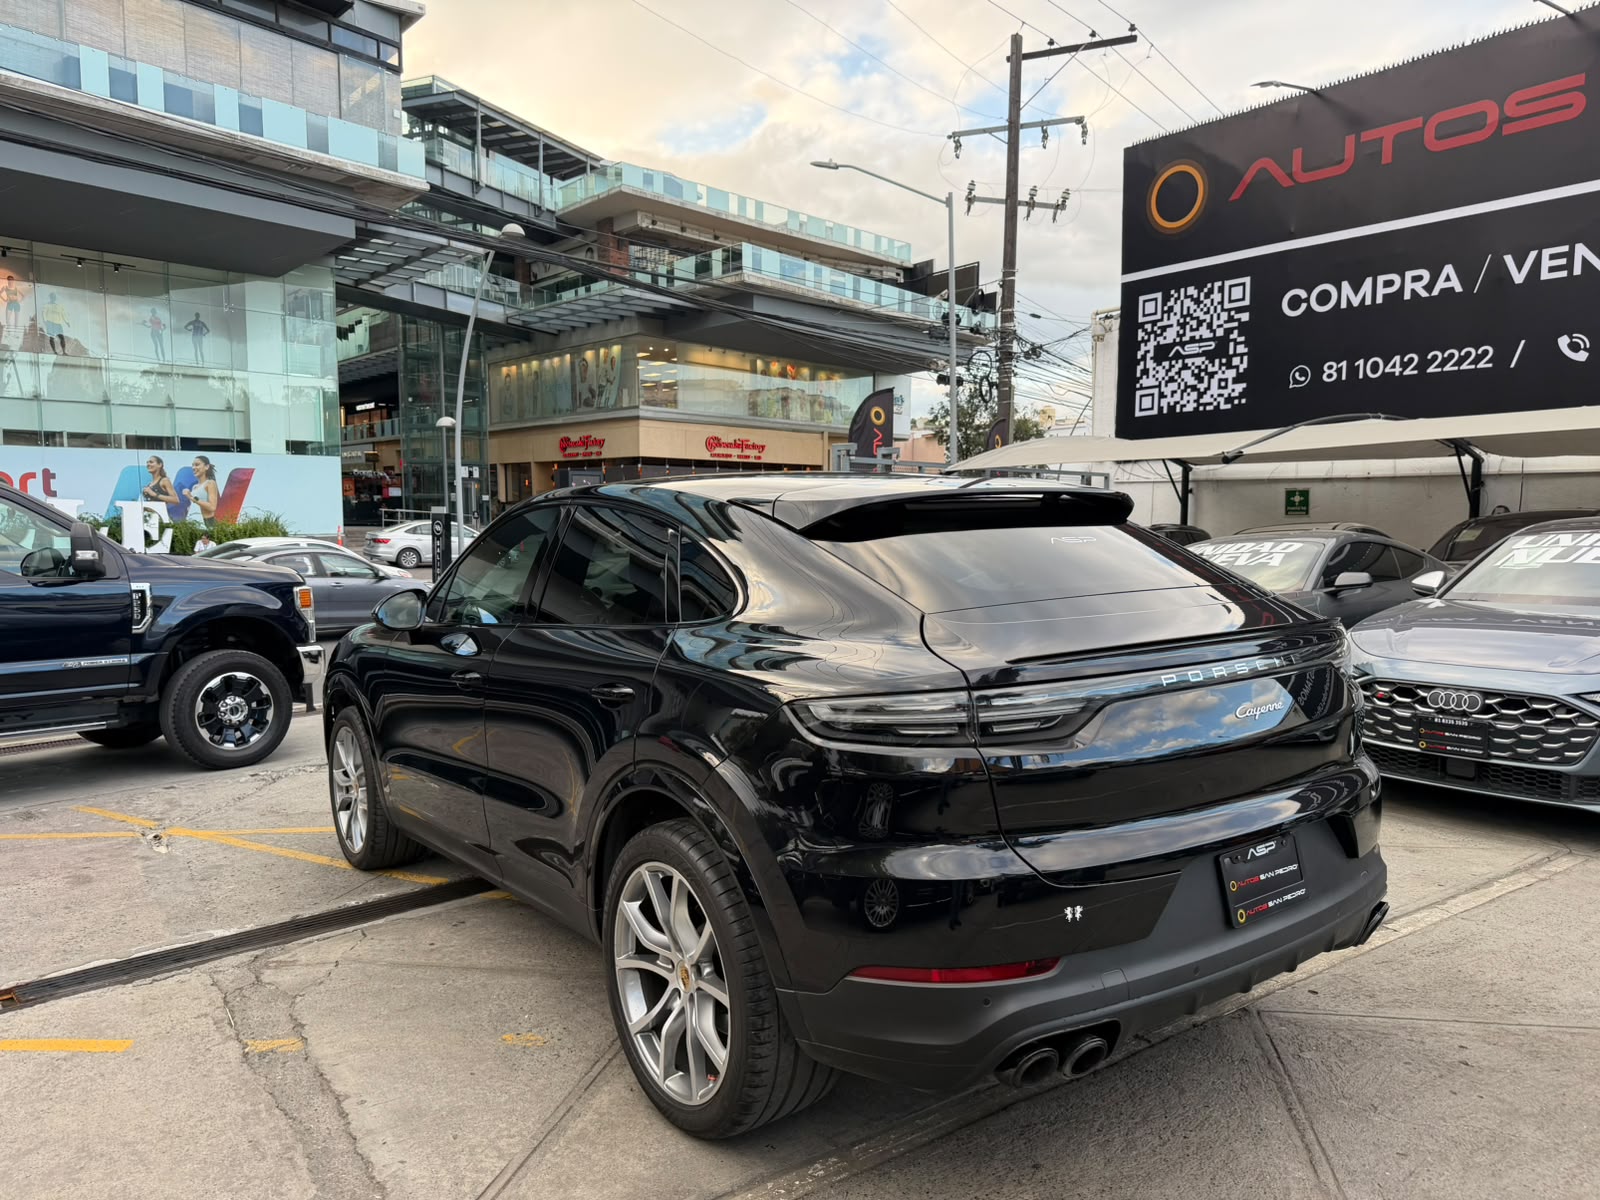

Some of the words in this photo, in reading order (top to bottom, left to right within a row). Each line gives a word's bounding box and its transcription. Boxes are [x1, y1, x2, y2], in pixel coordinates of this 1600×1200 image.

[1228, 72, 1587, 201] AUTOS
[1280, 264, 1463, 318] COMPRA
[1168, 341, 1216, 357] ASP
[1322, 360, 1347, 383] 81
[1354, 353, 1419, 379] 1042
[1426, 345, 1494, 373] 2222
[1235, 700, 1285, 721] Cayenne
[1247, 841, 1276, 860] ASP
[1237, 876, 1261, 888] AUTOS
[1260, 871, 1275, 881] SAN
[1275, 864, 1299, 876] PEDRO
[1246, 903, 1269, 916] AUTOS
[1268, 897, 1283, 908] SAN
[1283, 888, 1306, 902] PEDRO
